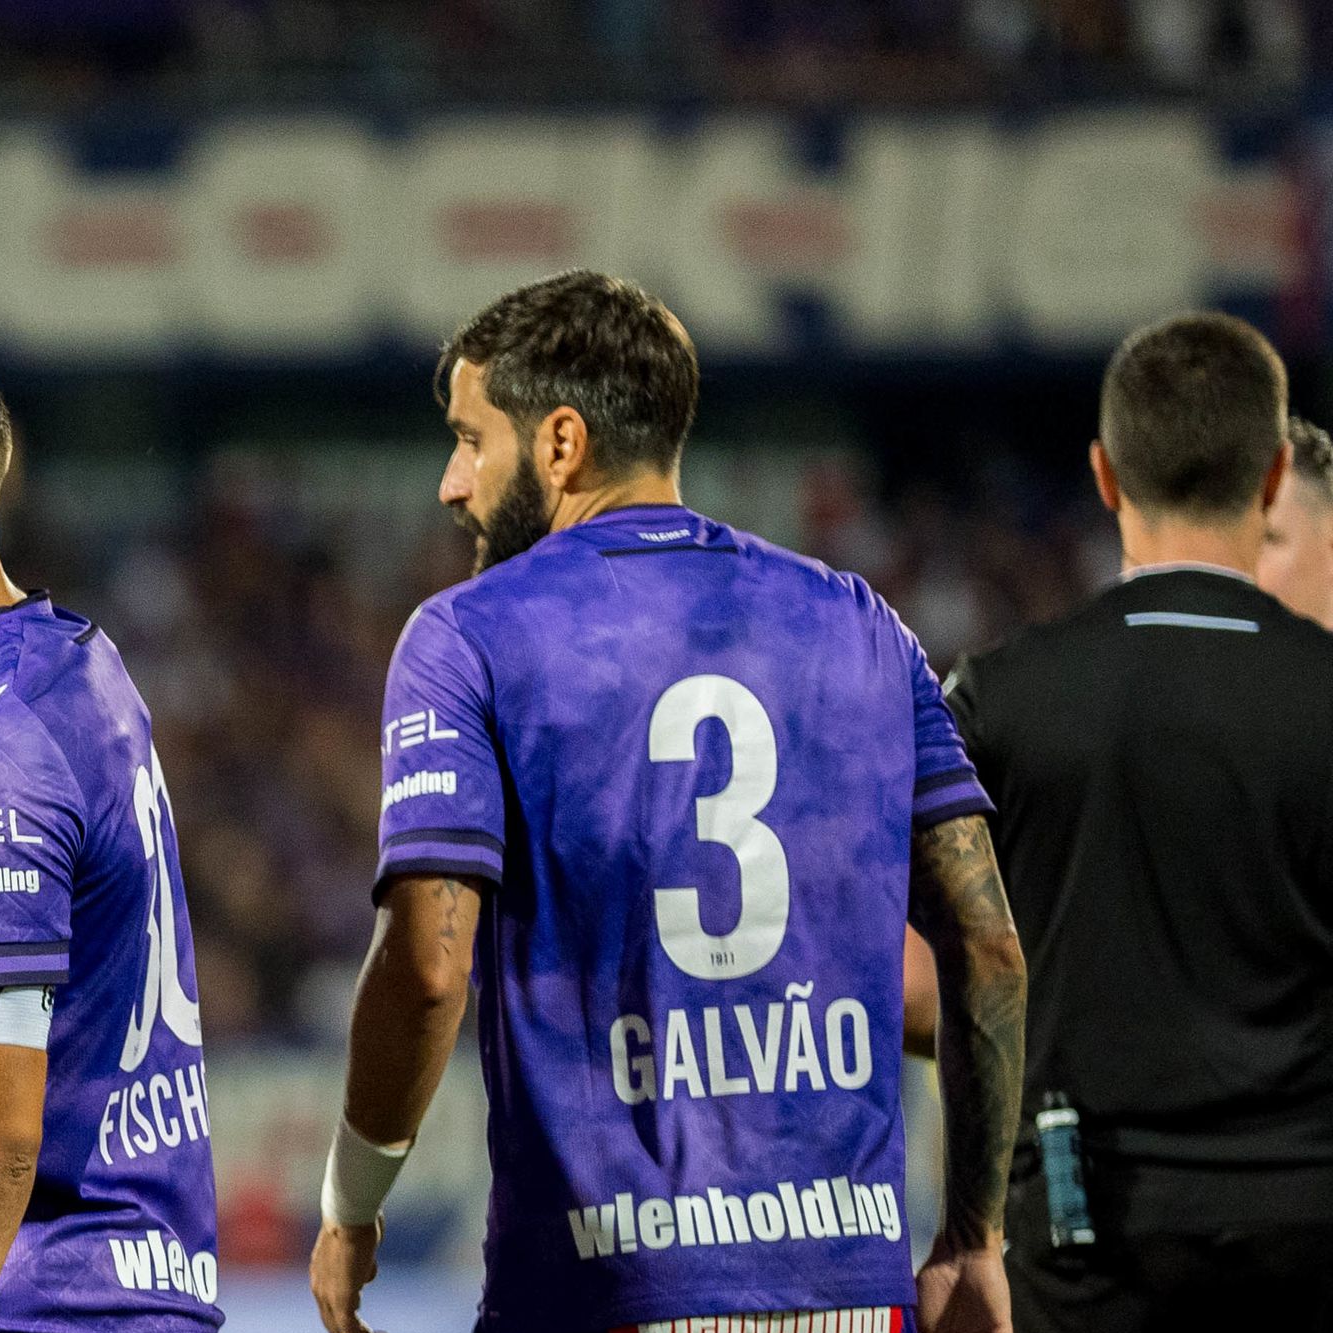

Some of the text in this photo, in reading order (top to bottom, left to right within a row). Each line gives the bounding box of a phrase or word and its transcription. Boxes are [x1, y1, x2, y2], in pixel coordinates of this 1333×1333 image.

[649, 673, 790, 980] 3
[609, 980, 874, 1105] GALVÃO
[100, 1060, 210, 1166] FISCH
